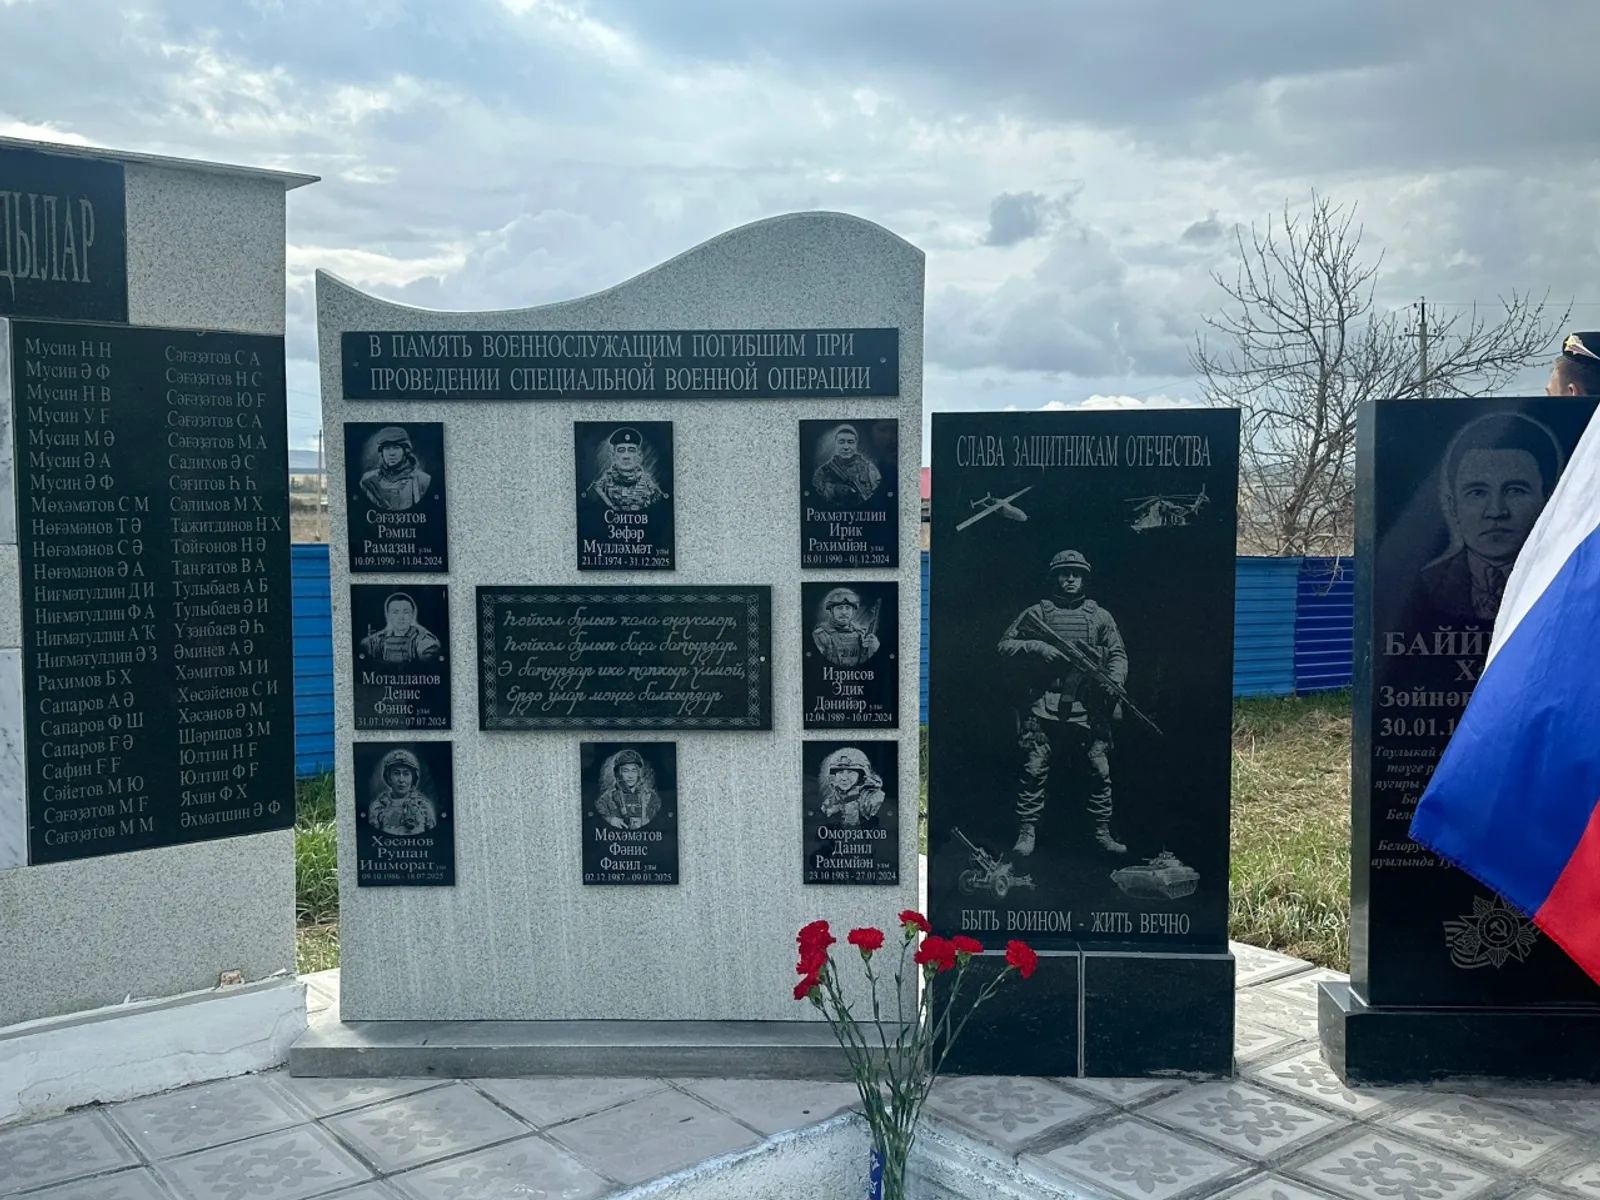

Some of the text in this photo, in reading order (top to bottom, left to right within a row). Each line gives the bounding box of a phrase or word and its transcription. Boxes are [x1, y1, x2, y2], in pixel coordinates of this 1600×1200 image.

[25, 338, 112, 359] Мусин Н Н
[369, 333, 854, 360] В ПАМЯТЬ ВОЕННОСЛУЖАЩИМ ПОГИБШИМ ПРИ
[235, 349, 245, 366] С
[249, 351, 260, 366] А
[370, 361, 871, 395] ПРОВЕДЕНИИ СПЕЦИАЛЬНОЙ ВОЕННОЙ ОПЕРАЦИИ
[27, 383, 111, 404] Мусин Н В
[28, 406, 78, 427] Мусин
[84, 407, 95, 424] У
[29, 451, 80, 471] Мусин
[100, 452, 111, 468] А
[956, 435, 1212, 473] СЛАВА ЗАЩИТНИКАМ ОТЕЧЕСТВА
[118, 496, 130, 512] С
[134, 496, 150, 512] М
[116, 517, 128, 534] Т
[829, 522, 863, 540] Ирик
[241, 537, 252, 552] Н
[128, 581, 140, 599] Д
[143, 581, 155, 598] И
[173, 600, 240, 620] Тулыбаев
[257, 598, 268, 613] И
[229, 640, 240, 655] А
[1383, 625, 1492, 656] БАЙЙ
[38, 668, 132, 691] Рахимов Б Х
[362, 671, 441, 685] Моталлапов
[382, 686, 421, 702] Денис
[831, 681, 865, 696] Эдик
[250, 701, 263, 717] М
[41, 712, 143, 737] Сапаров Ф Ш
[245, 722, 253, 737] З
[257, 721, 270, 736] М
[1380, 717, 1455, 737] 30.01.1
[42, 741, 105, 759] Сапаров
[180, 749, 228, 766] Юлтин
[232, 743, 244, 759] Н
[43, 762, 92, 781] Сафин
[180, 783, 248, 806] Яхин Ф Х
[267, 800, 281, 814] Ф
[377, 847, 428, 860] Рушан
[832, 841, 872, 856] Данил
[360, 860, 435, 873] Ишморат
[961, 909, 1000, 931] БЫТЬ
[1007, 910, 1072, 932] ВОИНОМ
[1091, 912, 1133, 934] ЖИТЬ
[1139, 913, 1190, 935] ВЕЧНО
